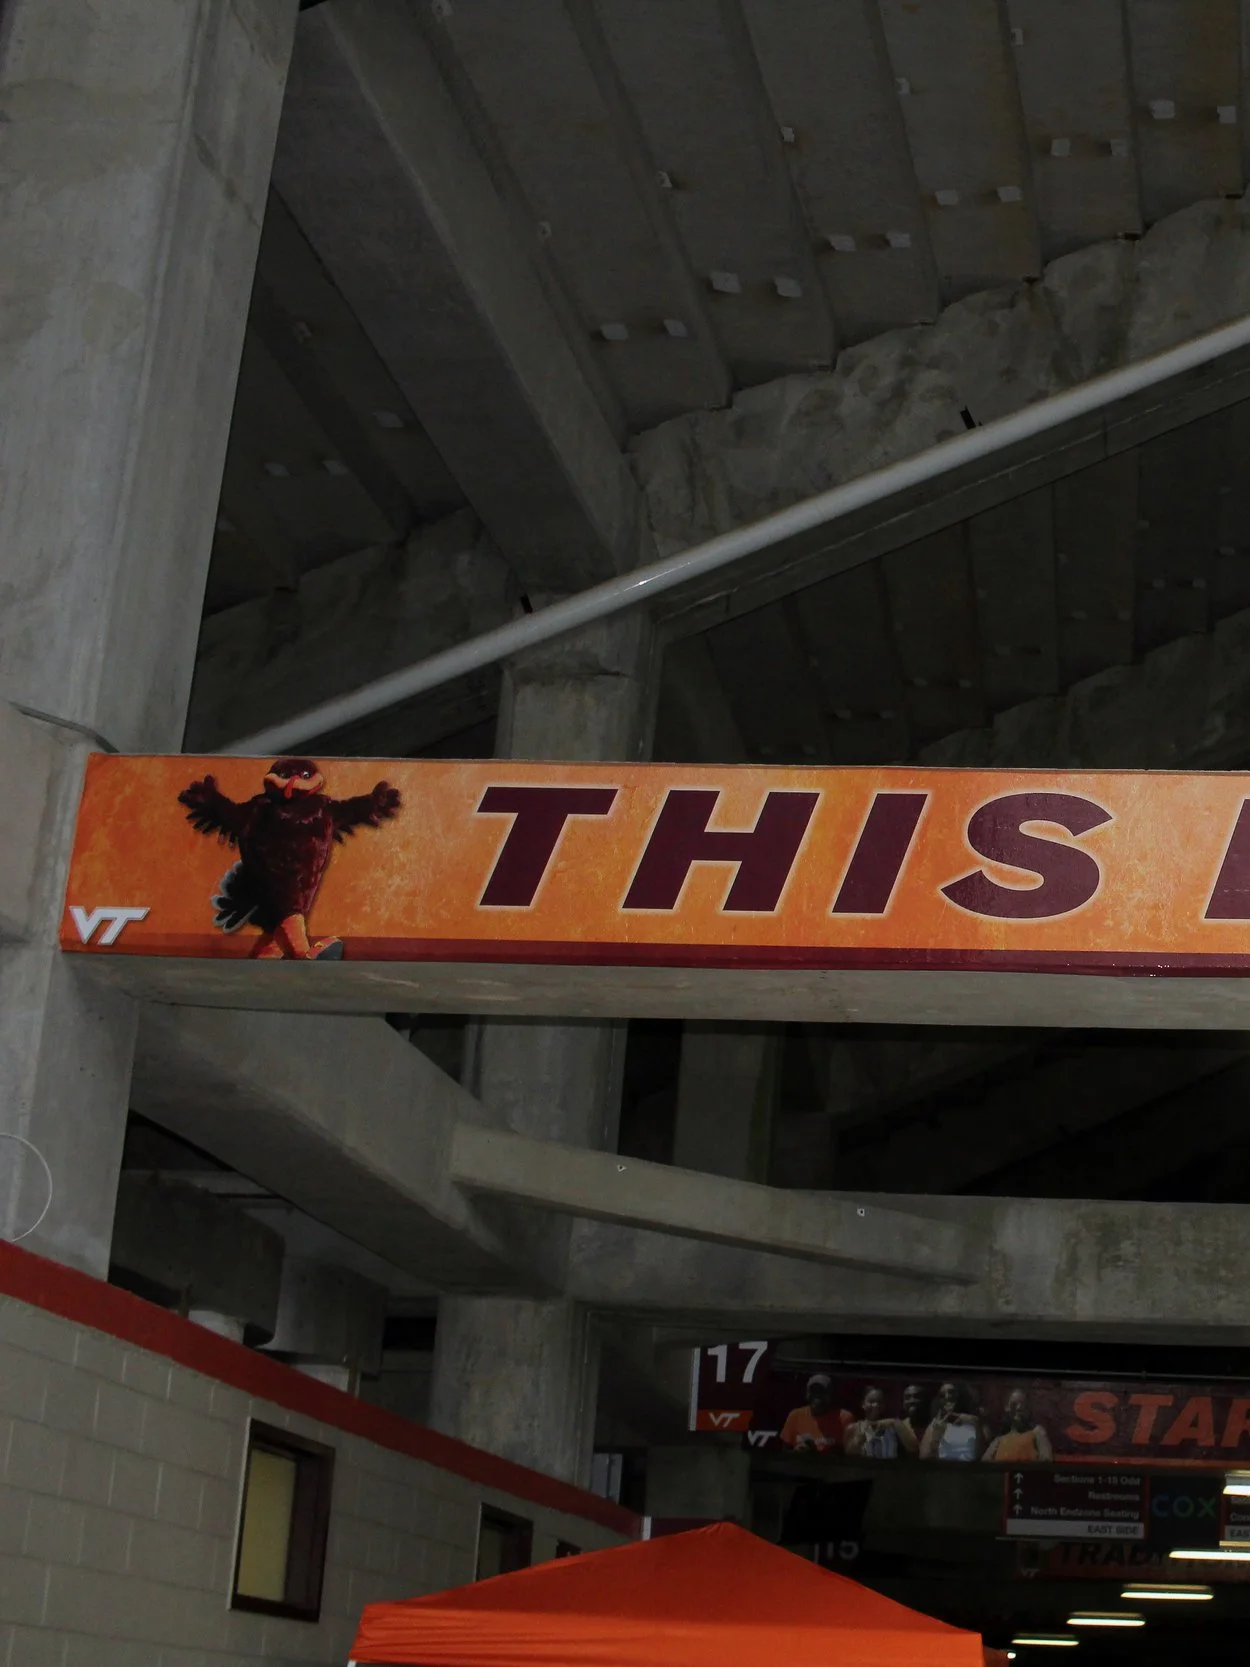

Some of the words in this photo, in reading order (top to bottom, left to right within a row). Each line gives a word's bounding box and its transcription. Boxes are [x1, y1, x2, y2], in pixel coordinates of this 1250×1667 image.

[475, 784, 1115, 921] THIS
[68, 905, 150, 947] VT
[706, 1341, 769, 1384] 17
[707, 1411, 741, 1428] VT
[747, 1429, 779, 1448] VT
[1087, 1490, 1140, 1502] Restrooms
[1030, 1506, 1058, 1517] North
[1060, 1507, 1102, 1518] Endzone
[1103, 1508, 1140, 1520] Seating
[1151, 1495, 1217, 1520] COX
[1087, 1524, 1113, 1535] EAST
[1115, 1525, 1139, 1536] SIDE
